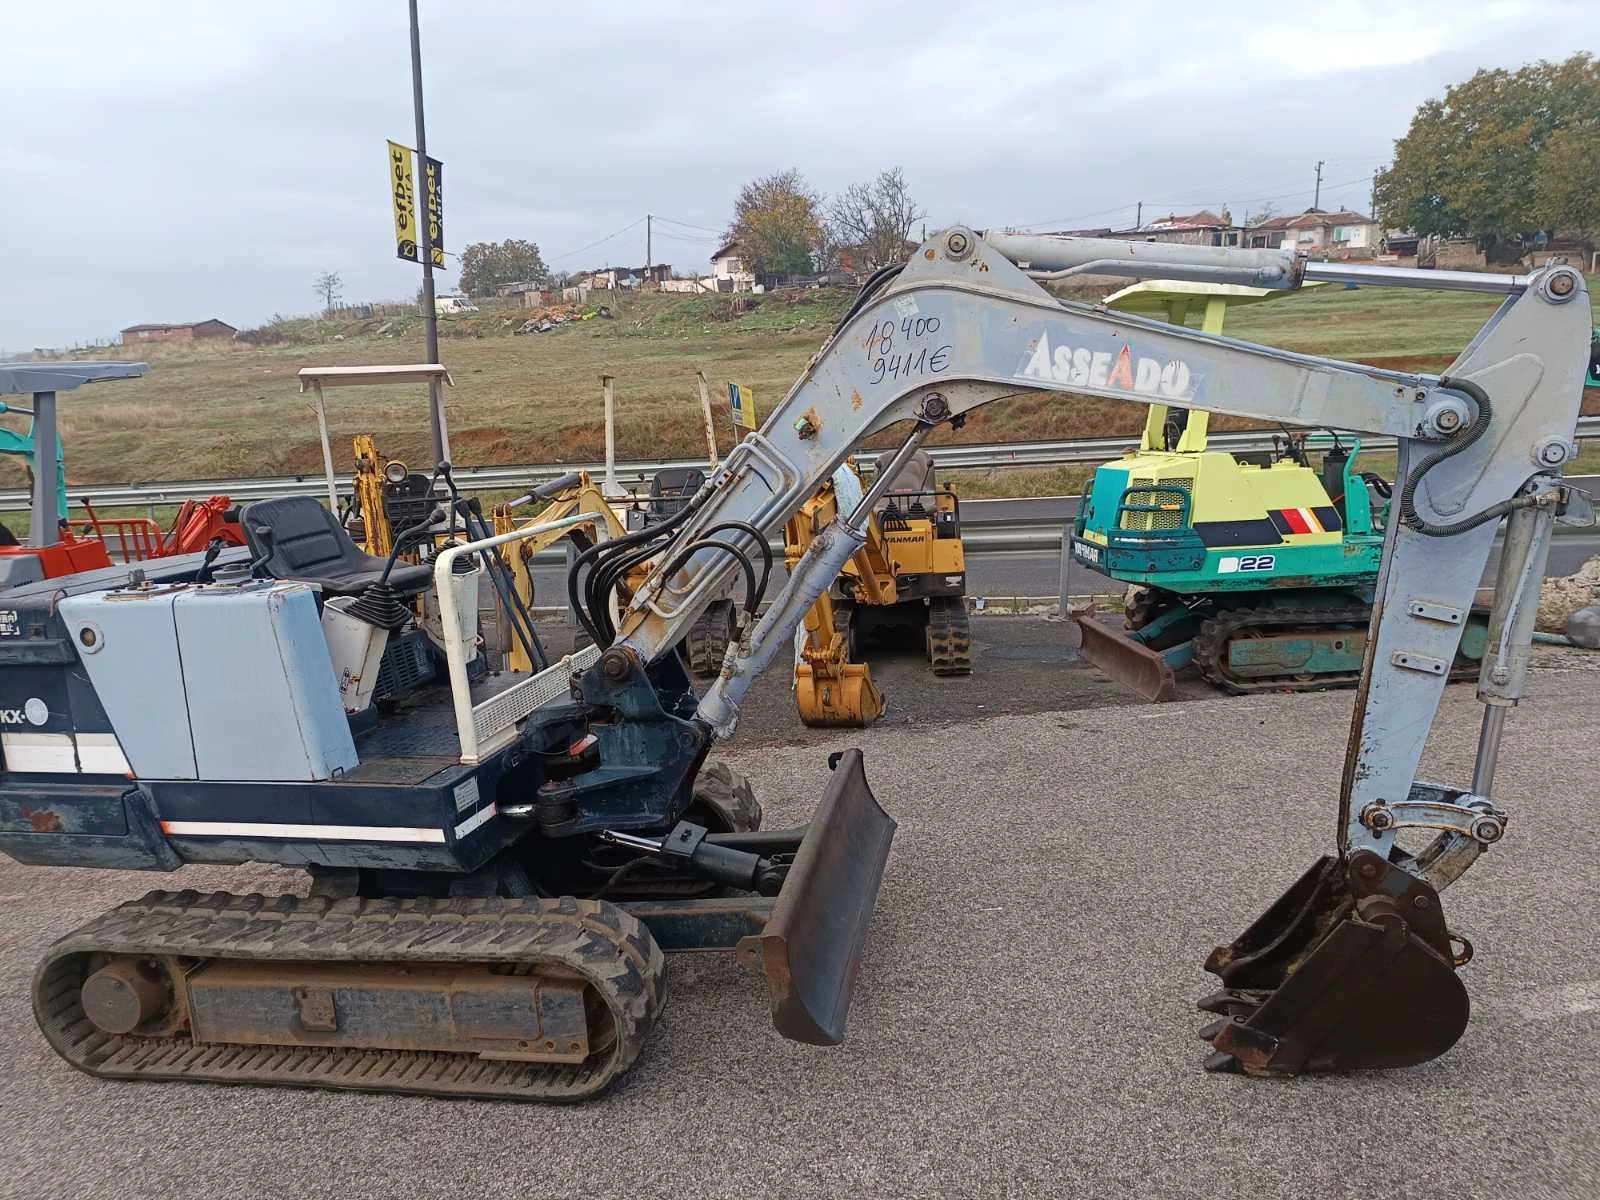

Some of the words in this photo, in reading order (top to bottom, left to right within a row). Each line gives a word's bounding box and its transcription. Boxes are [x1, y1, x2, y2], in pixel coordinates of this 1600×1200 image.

[392, 149, 408, 231] efbet
[426, 162, 438, 241] efbet
[865, 320, 895, 361] 18
[901, 317, 941, 341] 400
[884, 535, 925, 544] YANMAR
